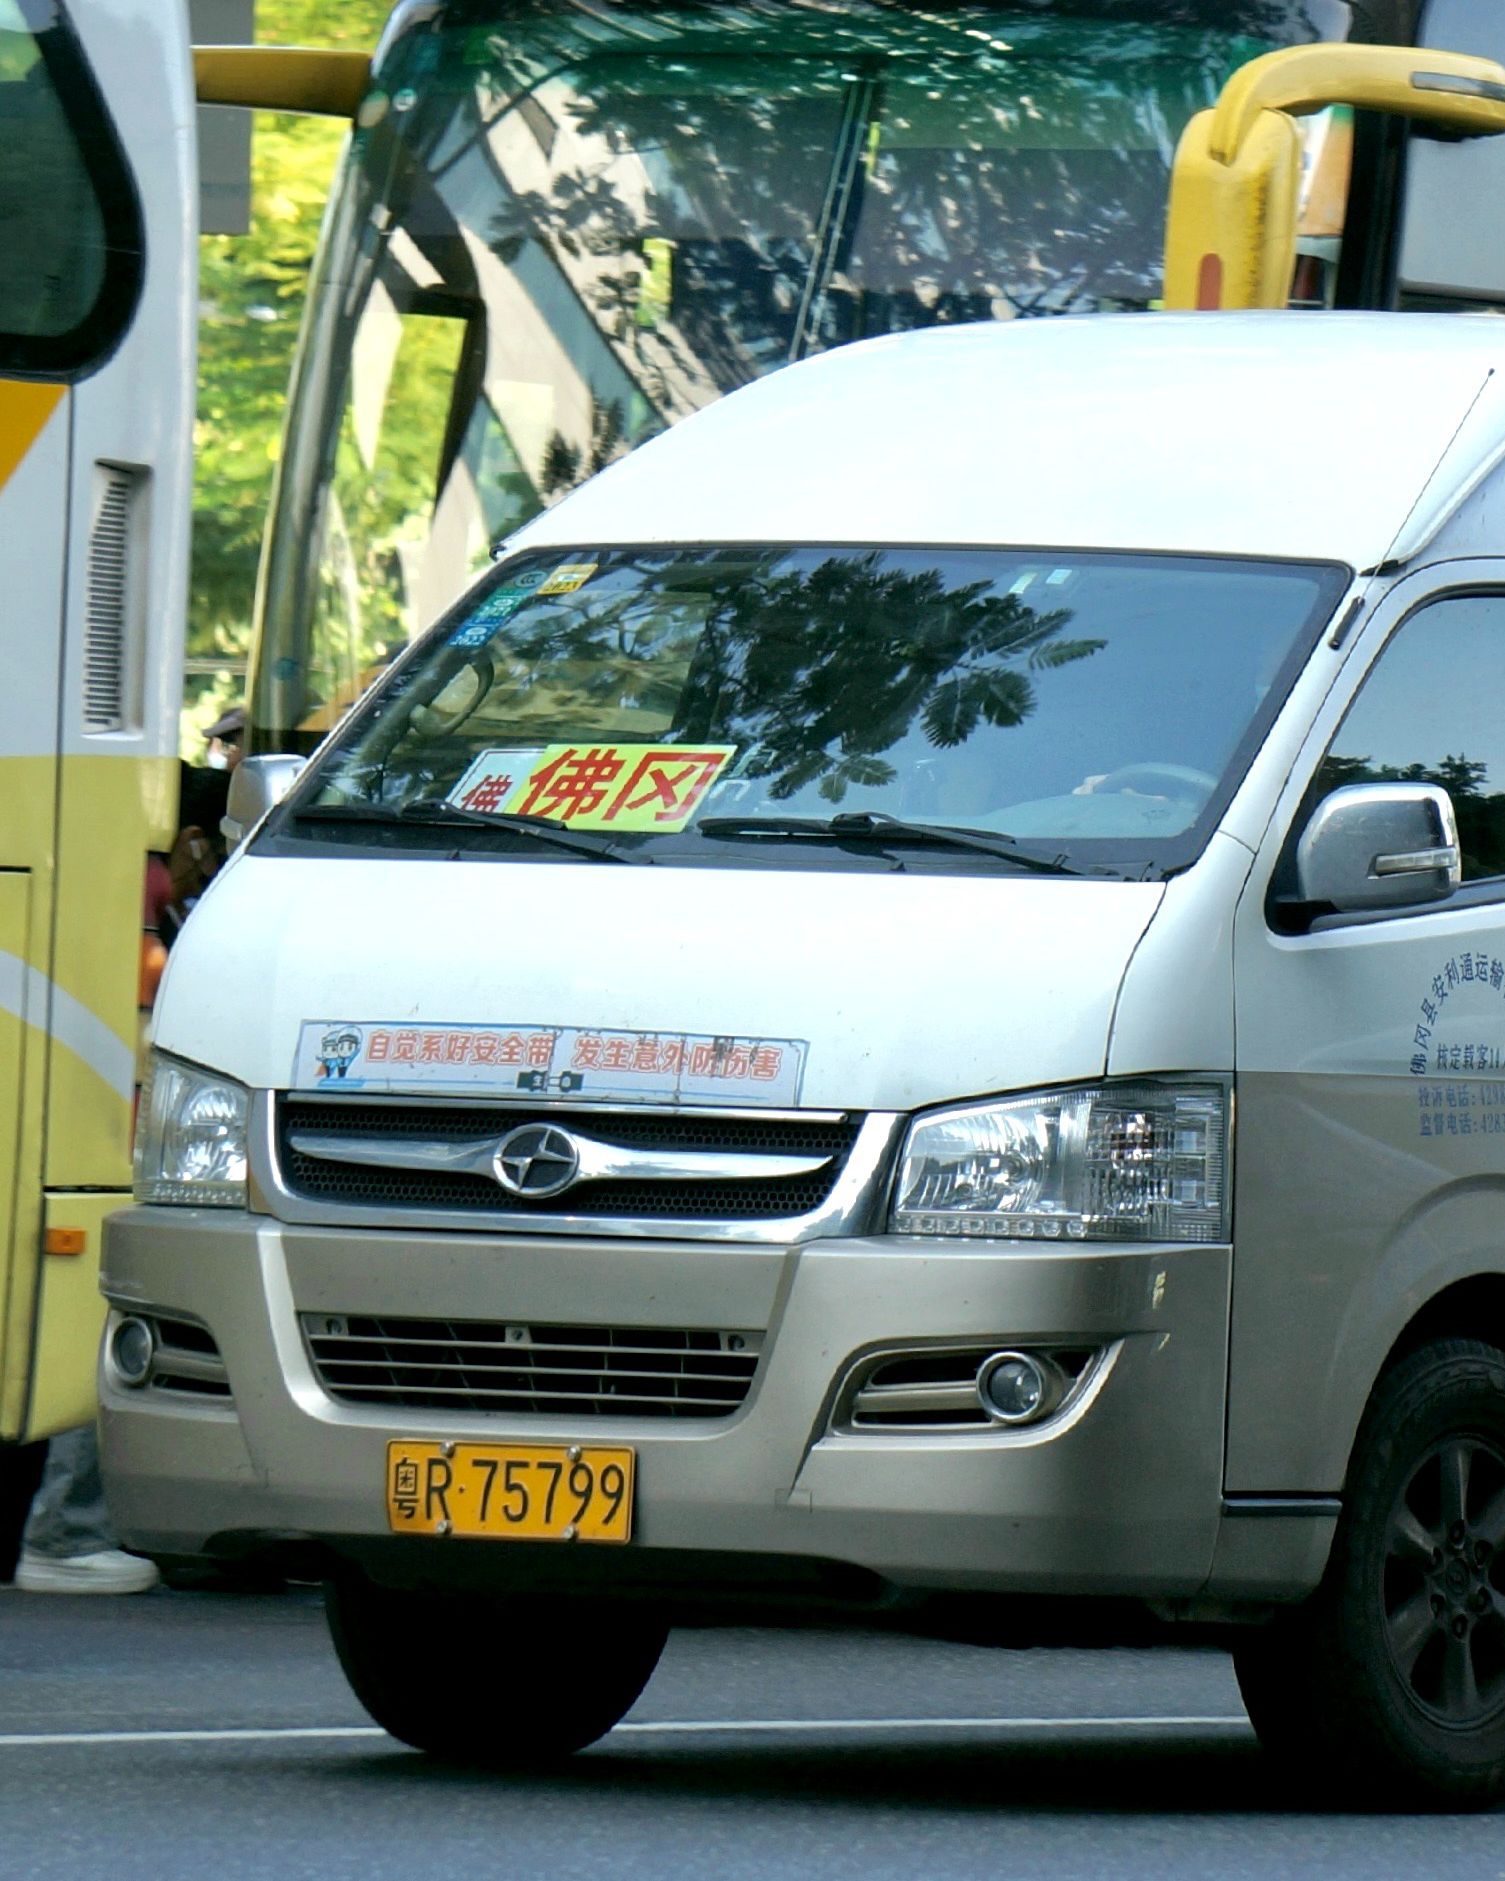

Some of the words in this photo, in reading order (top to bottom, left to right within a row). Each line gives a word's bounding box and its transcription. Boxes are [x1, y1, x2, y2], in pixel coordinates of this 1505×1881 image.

[462, 773, 515, 814] 佛
[518, 748, 726, 822] 佛冈
[366, 1029, 555, 1070] 自觉系好安全带
[575, 1035, 783, 1082] 发生意外防伤害
